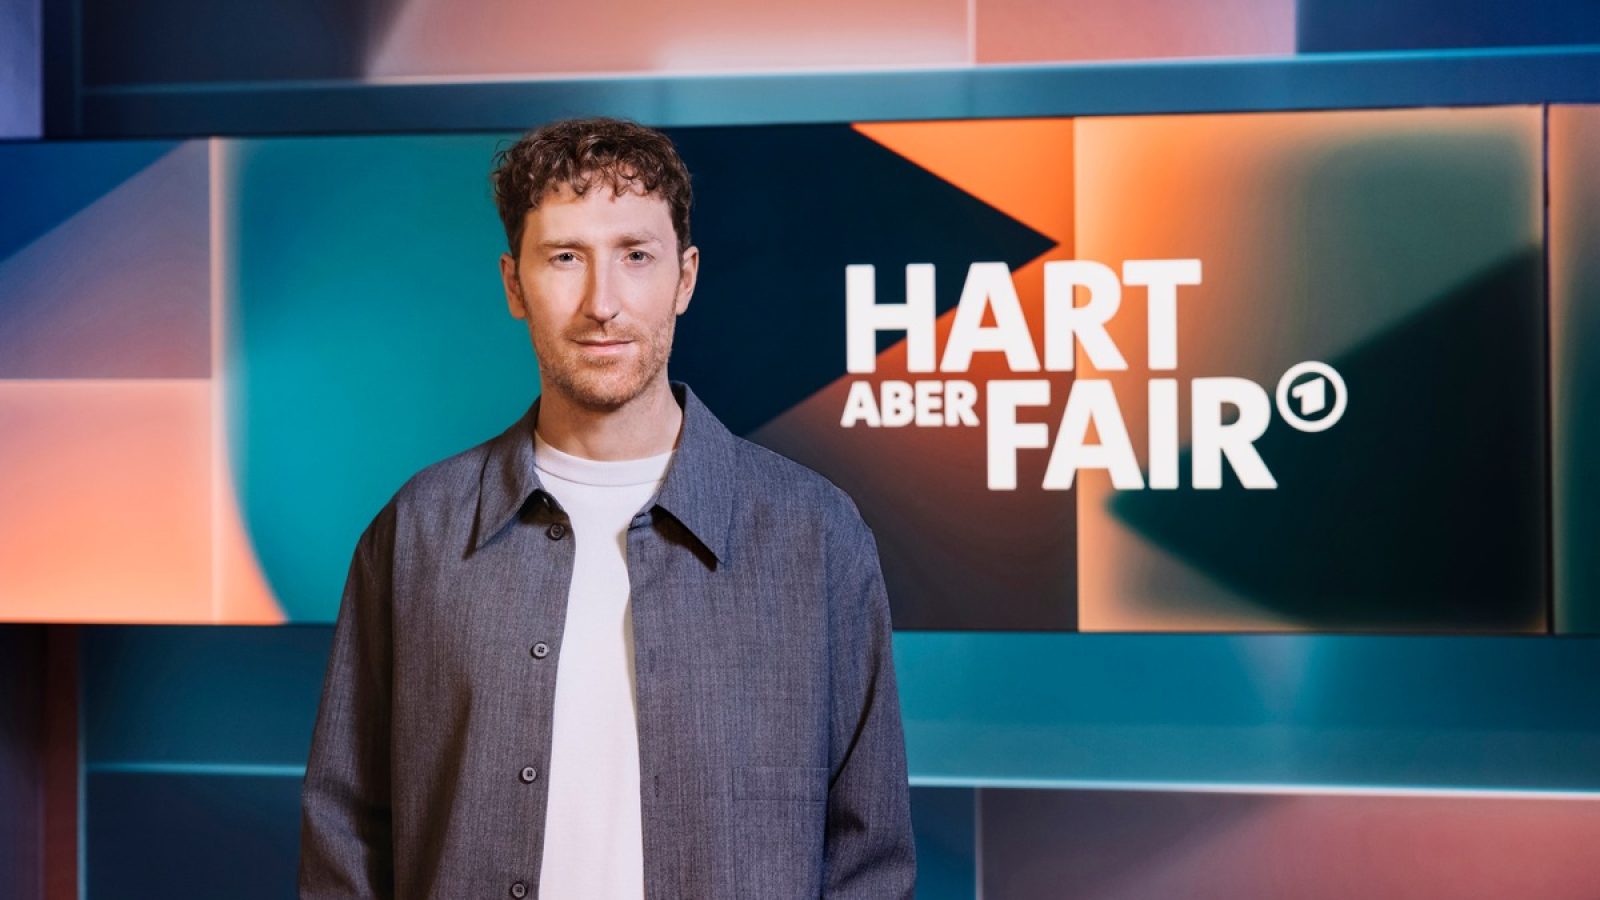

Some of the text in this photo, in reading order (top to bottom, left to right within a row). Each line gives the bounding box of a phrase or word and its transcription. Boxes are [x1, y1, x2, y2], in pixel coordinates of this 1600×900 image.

[845, 259, 1202, 373] HART
[841, 377, 1278, 490] ABER FAIR
